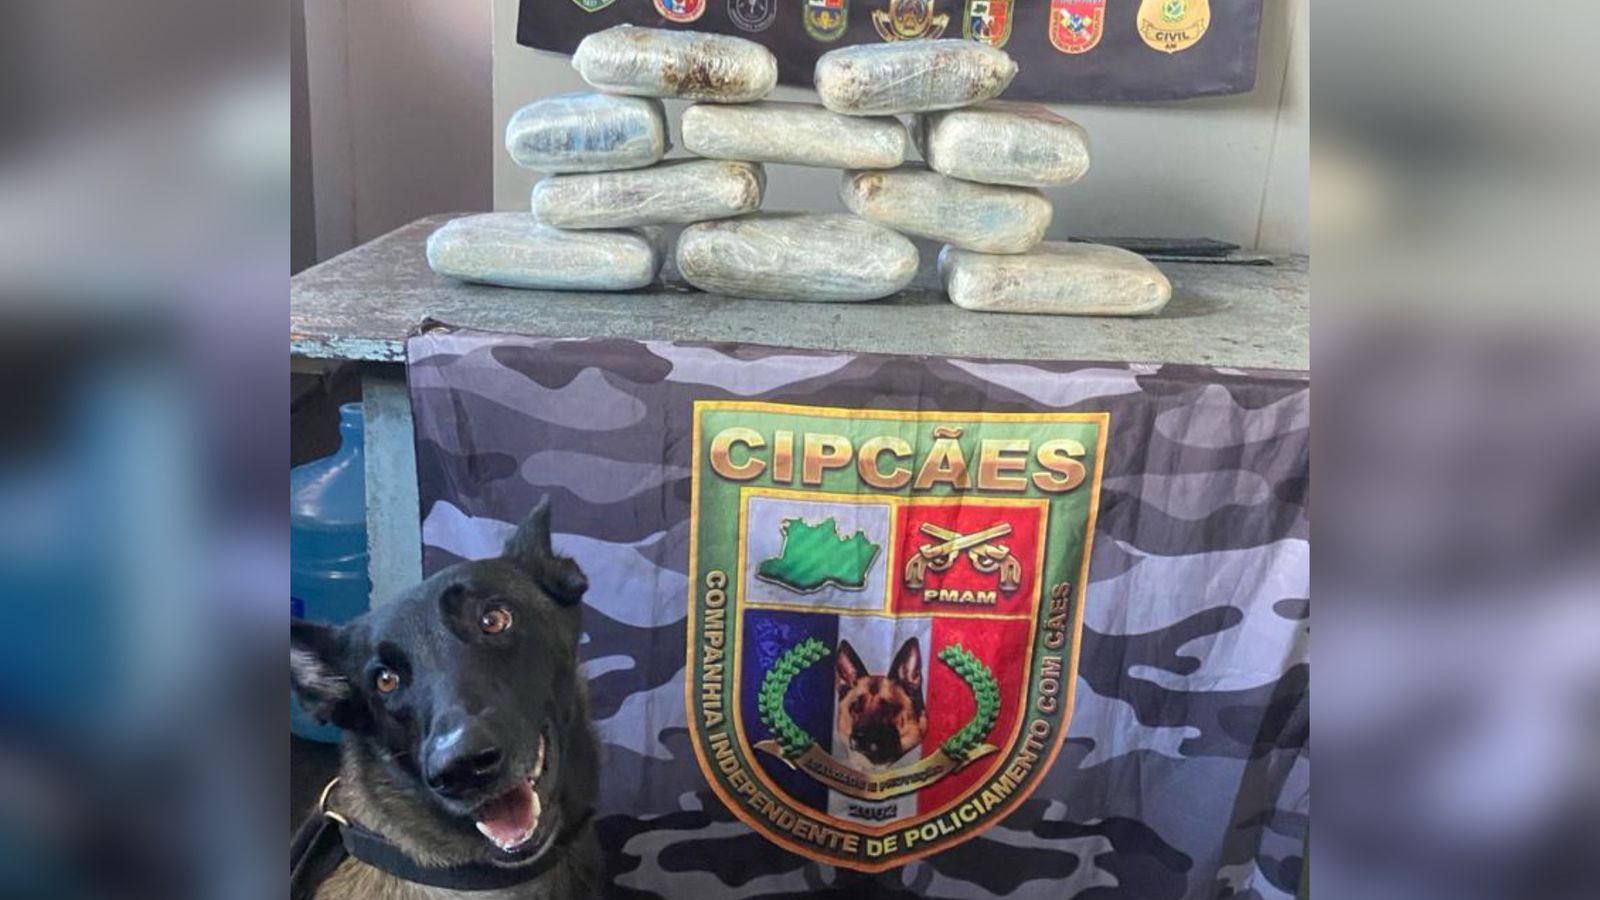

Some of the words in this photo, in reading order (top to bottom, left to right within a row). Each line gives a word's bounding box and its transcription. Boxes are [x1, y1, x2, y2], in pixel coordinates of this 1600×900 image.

[1155, 31, 1189, 41] CIVIL
[710, 427, 1087, 493] CIPCÃES
[924, 589, 997, 604] PMAM
[1044, 581, 1071, 648] CÃES
[702, 570, 727, 727] COMPANHIA
[1037, 655, 1062, 713] COM
[709, 732, 860, 852] INDEPENDENTE
[905, 719, 1050, 848] POLICIAMENTO
[867, 836, 898, 857] DE
